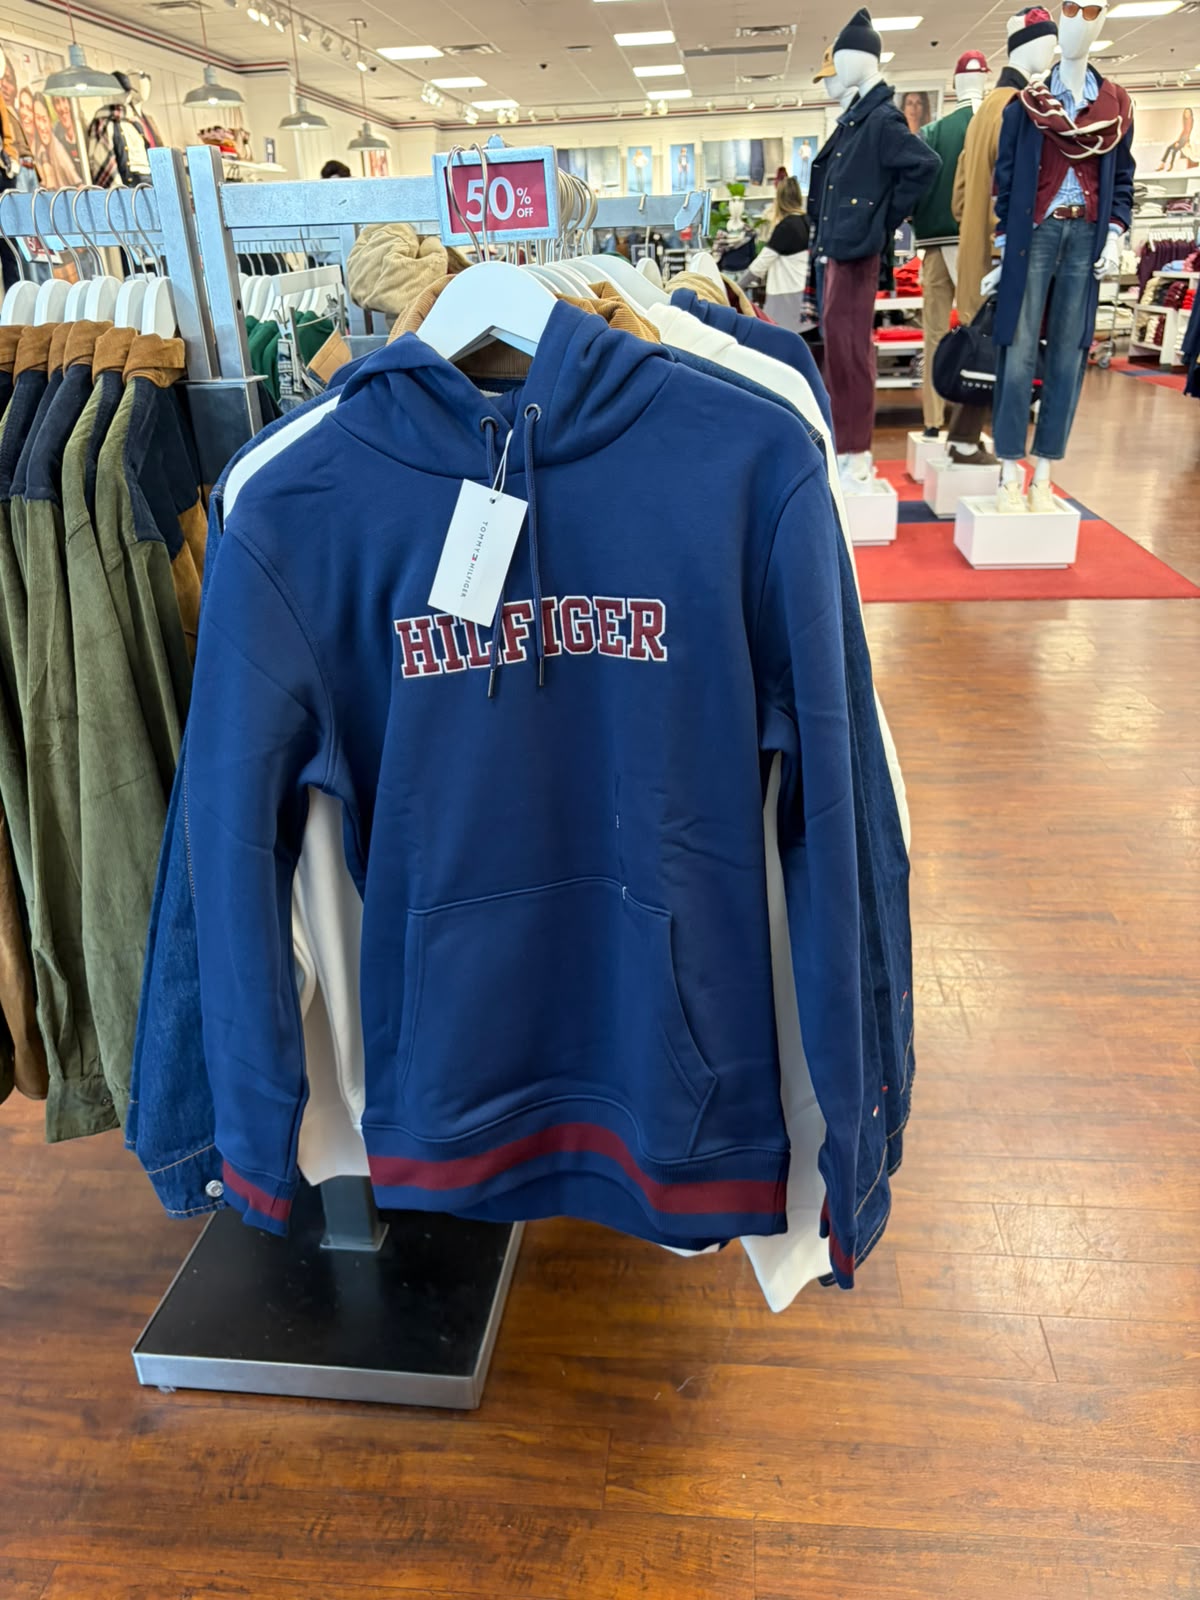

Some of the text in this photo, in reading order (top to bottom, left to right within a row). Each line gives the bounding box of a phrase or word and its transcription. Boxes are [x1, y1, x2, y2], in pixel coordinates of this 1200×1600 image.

[516, 207, 534, 218] OFF
[460, 521, 488, 598] TOMMY HILFIGER
[394, 596, 667, 678] HILFIGER
